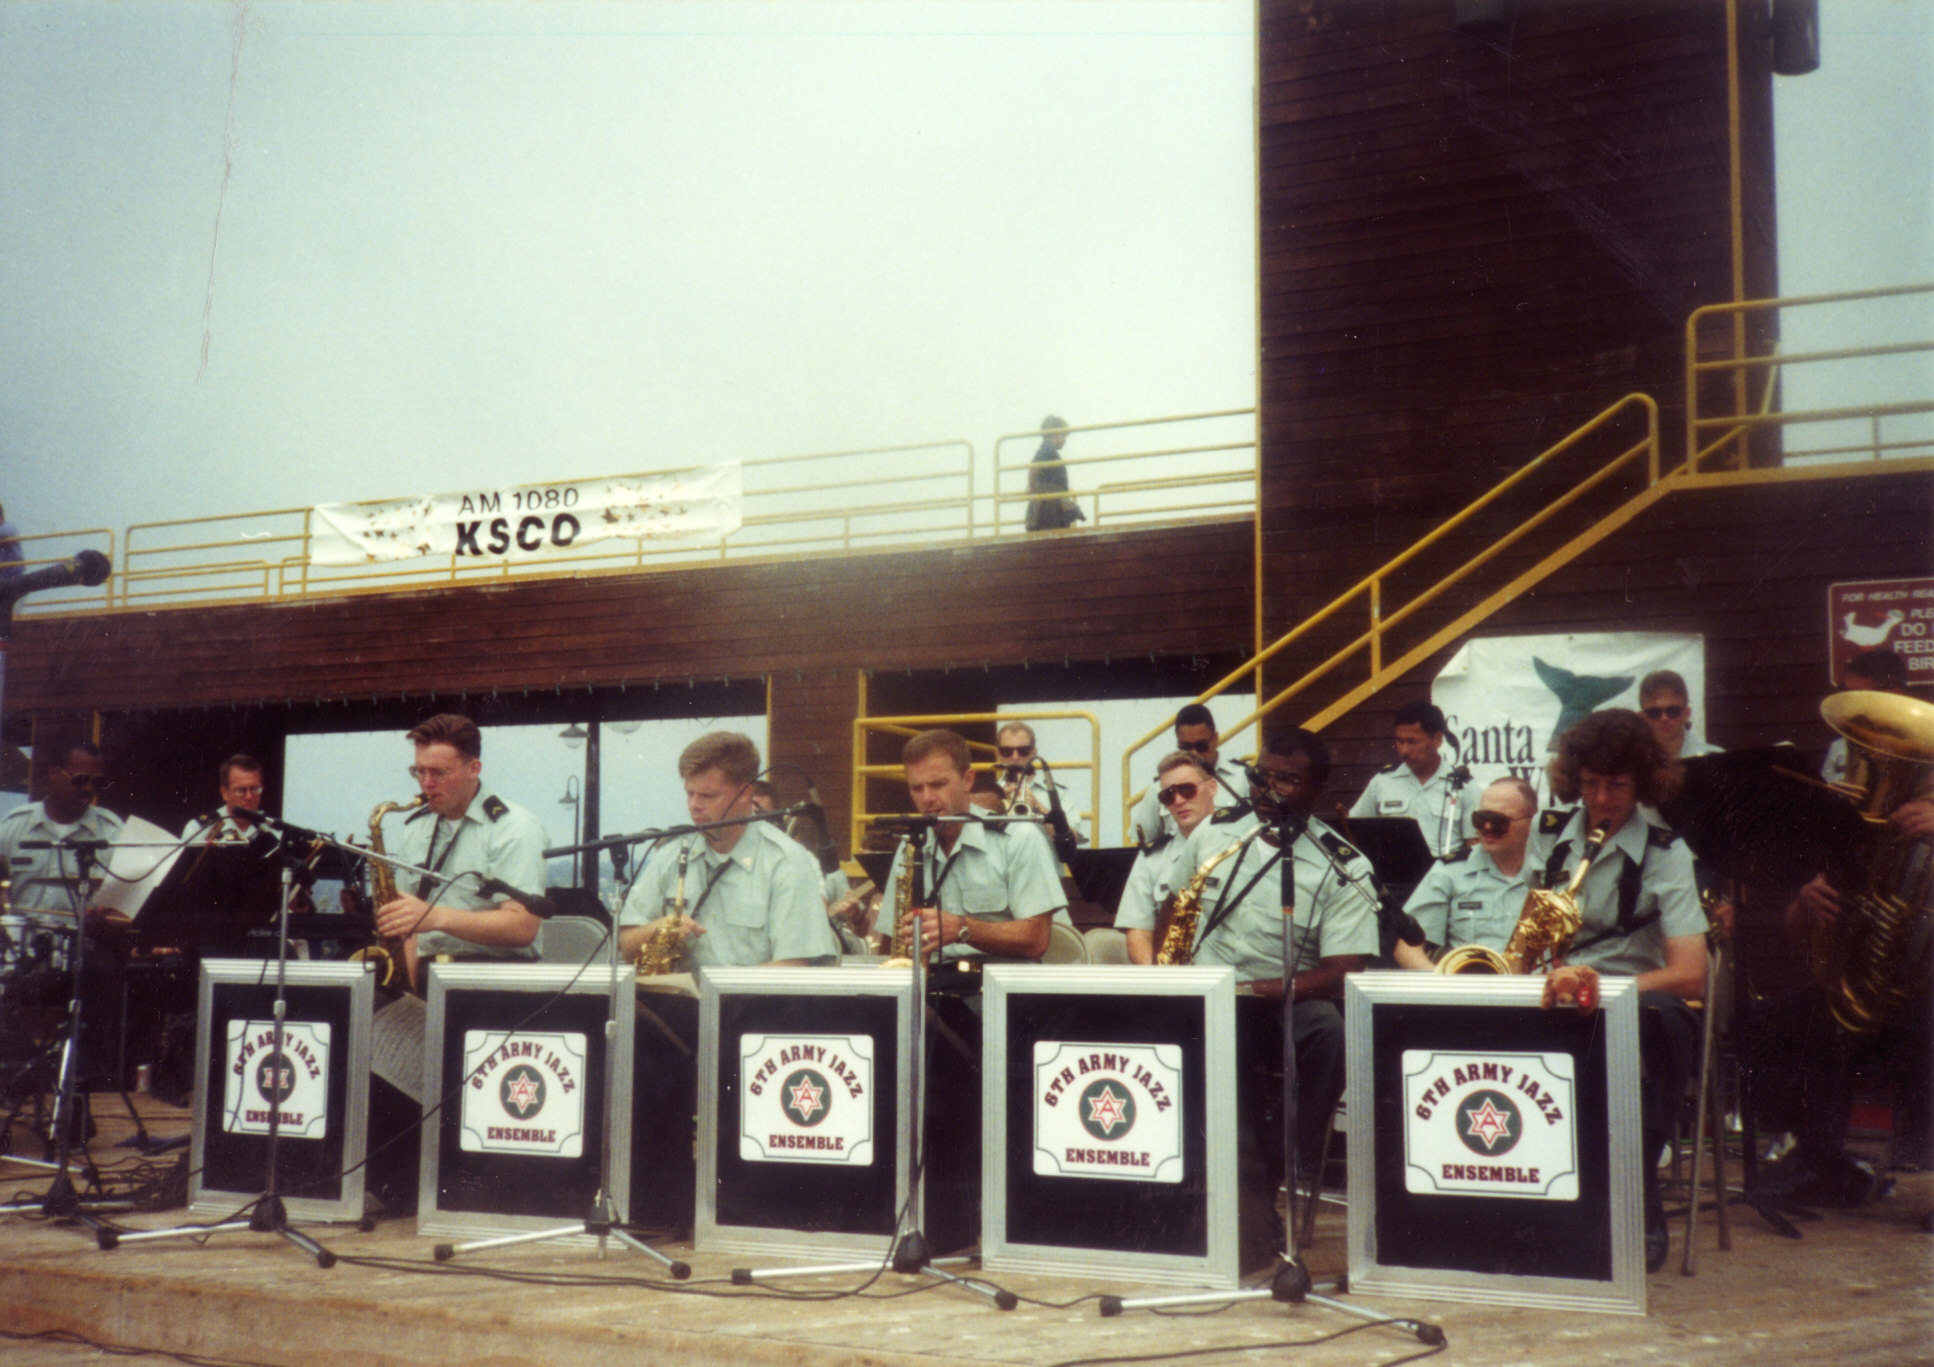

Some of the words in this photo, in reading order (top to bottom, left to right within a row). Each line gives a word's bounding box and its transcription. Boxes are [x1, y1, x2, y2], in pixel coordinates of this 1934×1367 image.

[457, 491, 500, 516] AM
[513, 487, 579, 511] 1080
[455, 512, 581, 556] KSCO
[1842, 592, 1864, 602] FOR
[1868, 590, 1909, 601] HEALTH
[1901, 622, 1926, 637] DO
[1894, 639, 1934, 654] FEED
[1443, 714, 1536, 767] Santa
[257, 1030, 294, 1049] ARY
[294, 1040, 321, 1080] JAZZ
[471, 1055, 498, 1090] 6TH
[501, 1041, 543, 1061] ARMY
[544, 1051, 576, 1094] JAZZ
[750, 1057, 778, 1097] 6TH
[780, 1044, 827, 1066] ARMY
[828, 1054, 864, 1100] JAZZ
[1044, 1066, 1076, 1108] 6TH
[1078, 1053, 1131, 1075] ARMY
[1132, 1064, 1172, 1113] JAZZ
[1415, 1076, 1451, 1121] 6TH
[1453, 1062, 1514, 1086] ARMY
[1516, 1073, 1564, 1126] JAZZ
[487, 1126, 556, 1143] ENSEMBLE
[768, 1134, 844, 1151] ENSEMBLE
[1065, 1147, 1151, 1167] ENSEMBLE
[1441, 1163, 1540, 1184] ENSEMBLE
